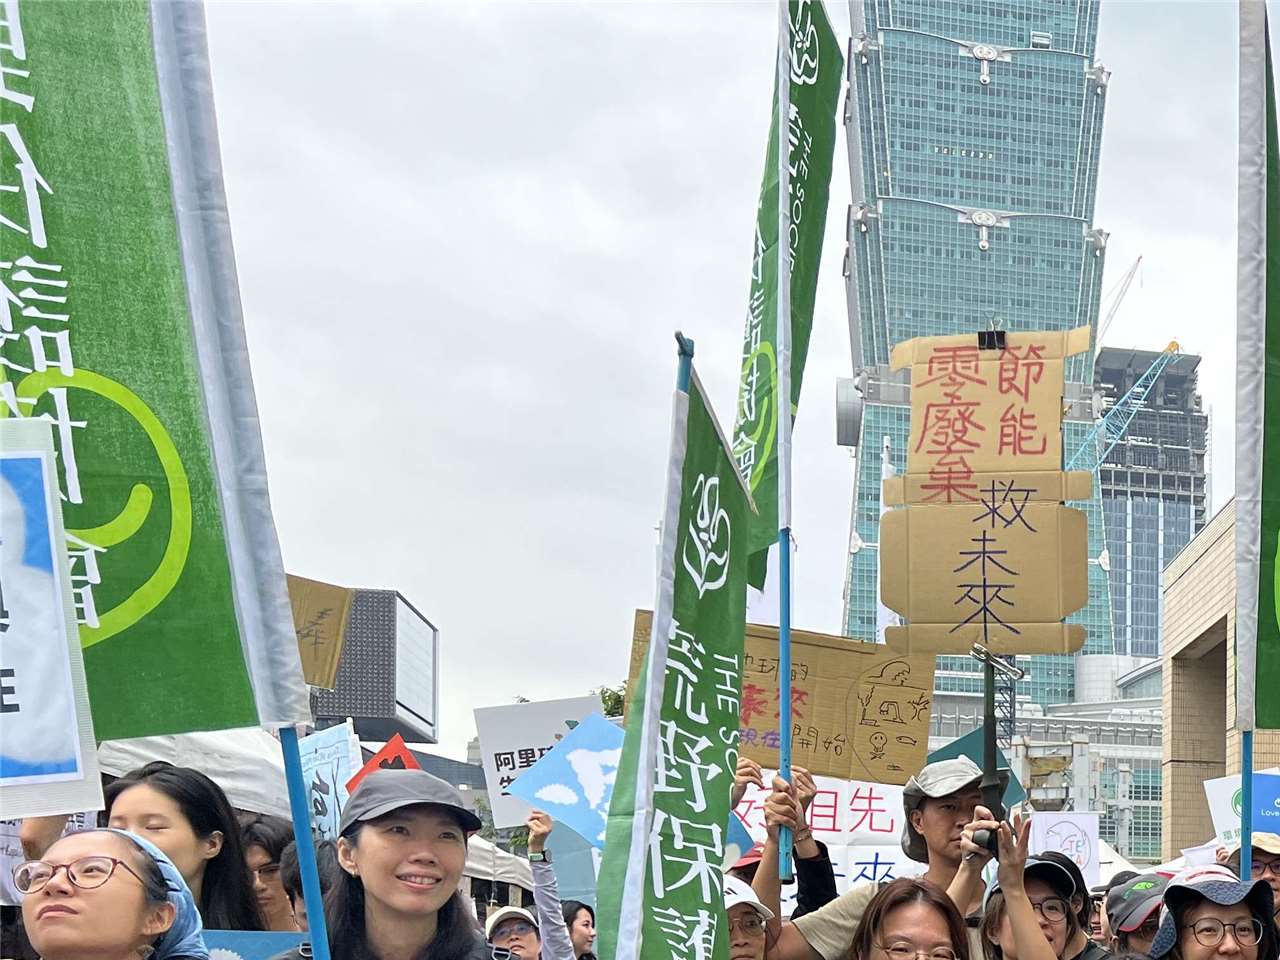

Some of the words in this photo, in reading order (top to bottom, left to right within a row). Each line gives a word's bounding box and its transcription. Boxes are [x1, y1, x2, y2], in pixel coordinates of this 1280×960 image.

[914, 346, 987, 504] 零廢棄
[996, 344, 1047, 457] 節能
[949, 479, 1038, 644] 救未來
[714, 653, 738, 717] THE
[1261, 808, 1280, 817] Love
